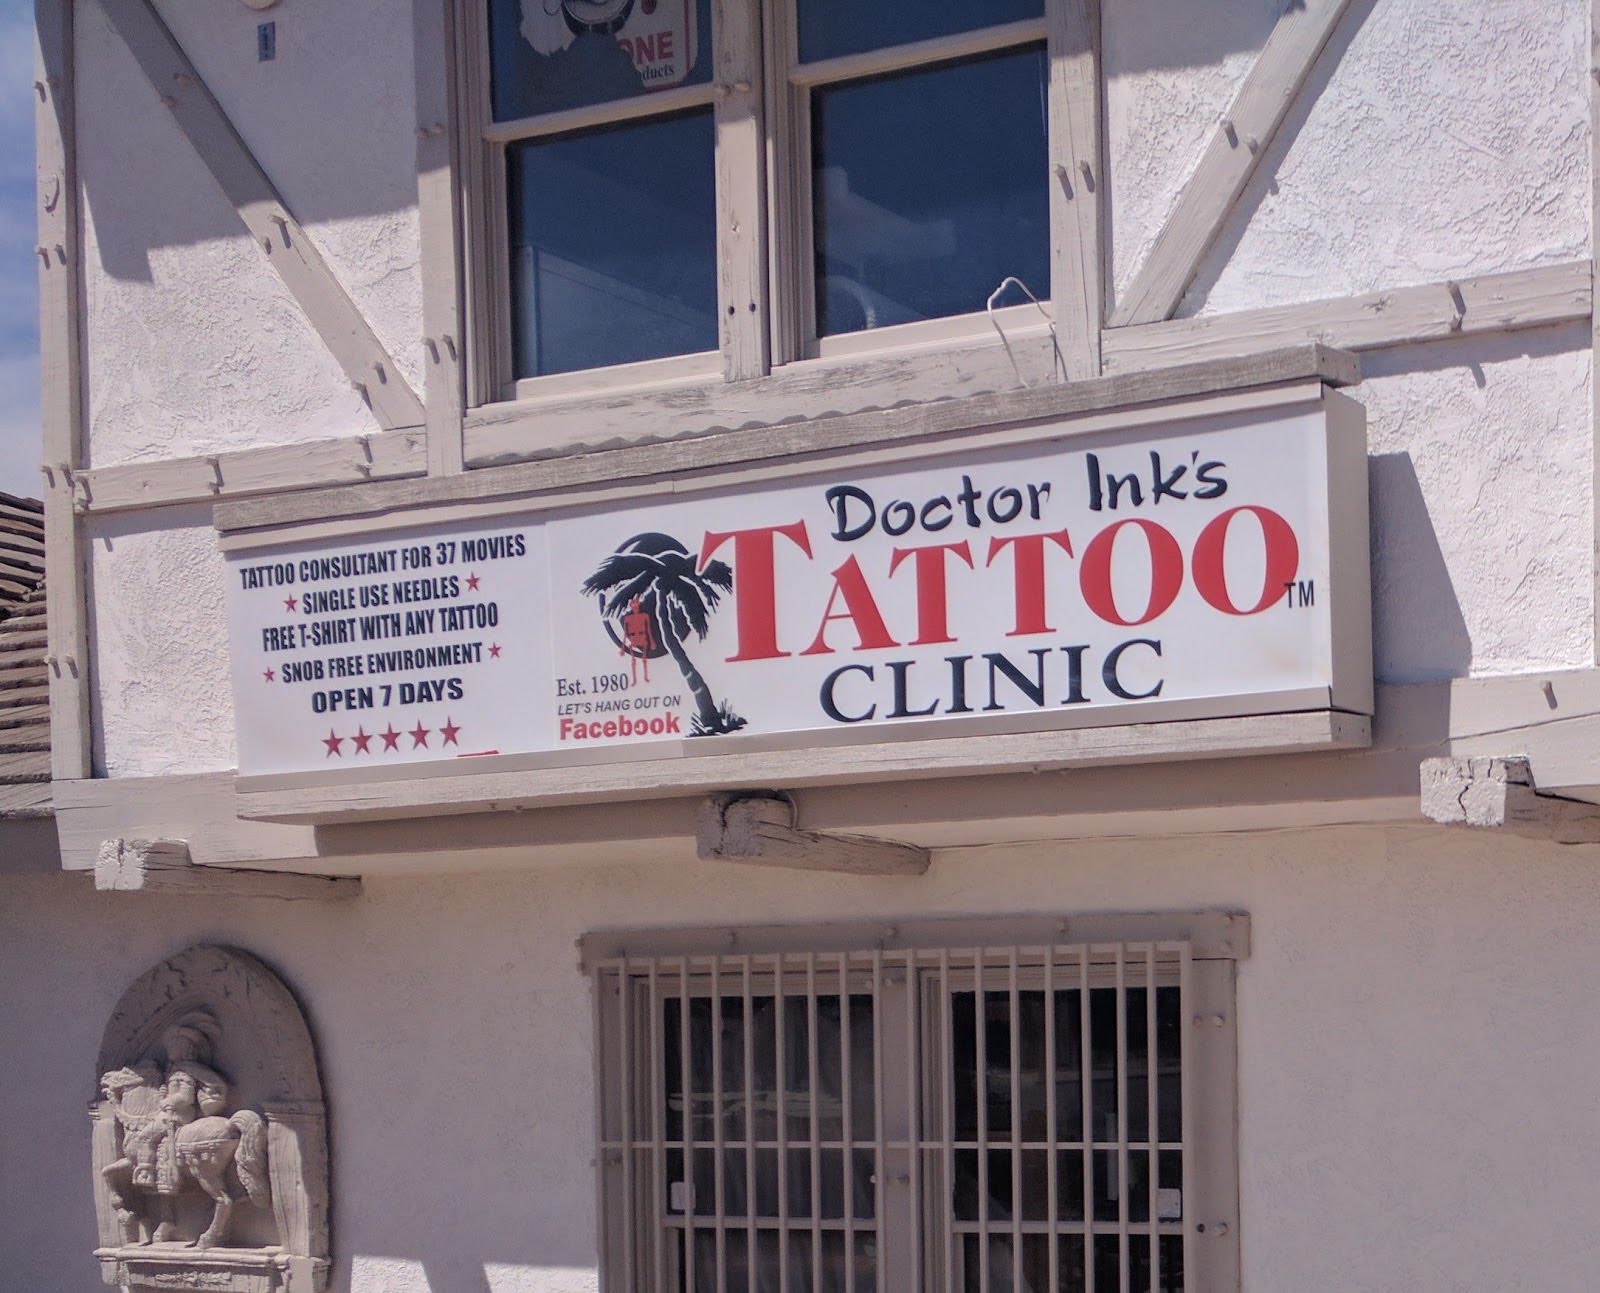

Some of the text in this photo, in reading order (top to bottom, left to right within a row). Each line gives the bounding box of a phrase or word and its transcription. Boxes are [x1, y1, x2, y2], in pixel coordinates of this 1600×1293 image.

[825, 450, 1229, 543] Doctor Ink's
[240, 533, 526, 589] TATTOO CONSULTANT FOR 37 MOVIES
[302, 575, 460, 615] SINGLE USE NEEDLES
[698, 504, 1300, 663] TATTOO
[262, 602, 499, 652] FREE T-SHIRT WITH ANY TATTOO
[281, 642, 483, 683] SNOB FREE ENVIRONMENT
[819, 638, 1165, 724] CLINIC
[311, 677, 464, 713] OPEN 7 DAYS
[556, 672, 629, 697] Est. 1980
[558, 695, 681, 716] LET'S HANG OUT ON
[559, 712, 680, 740] Facebook
